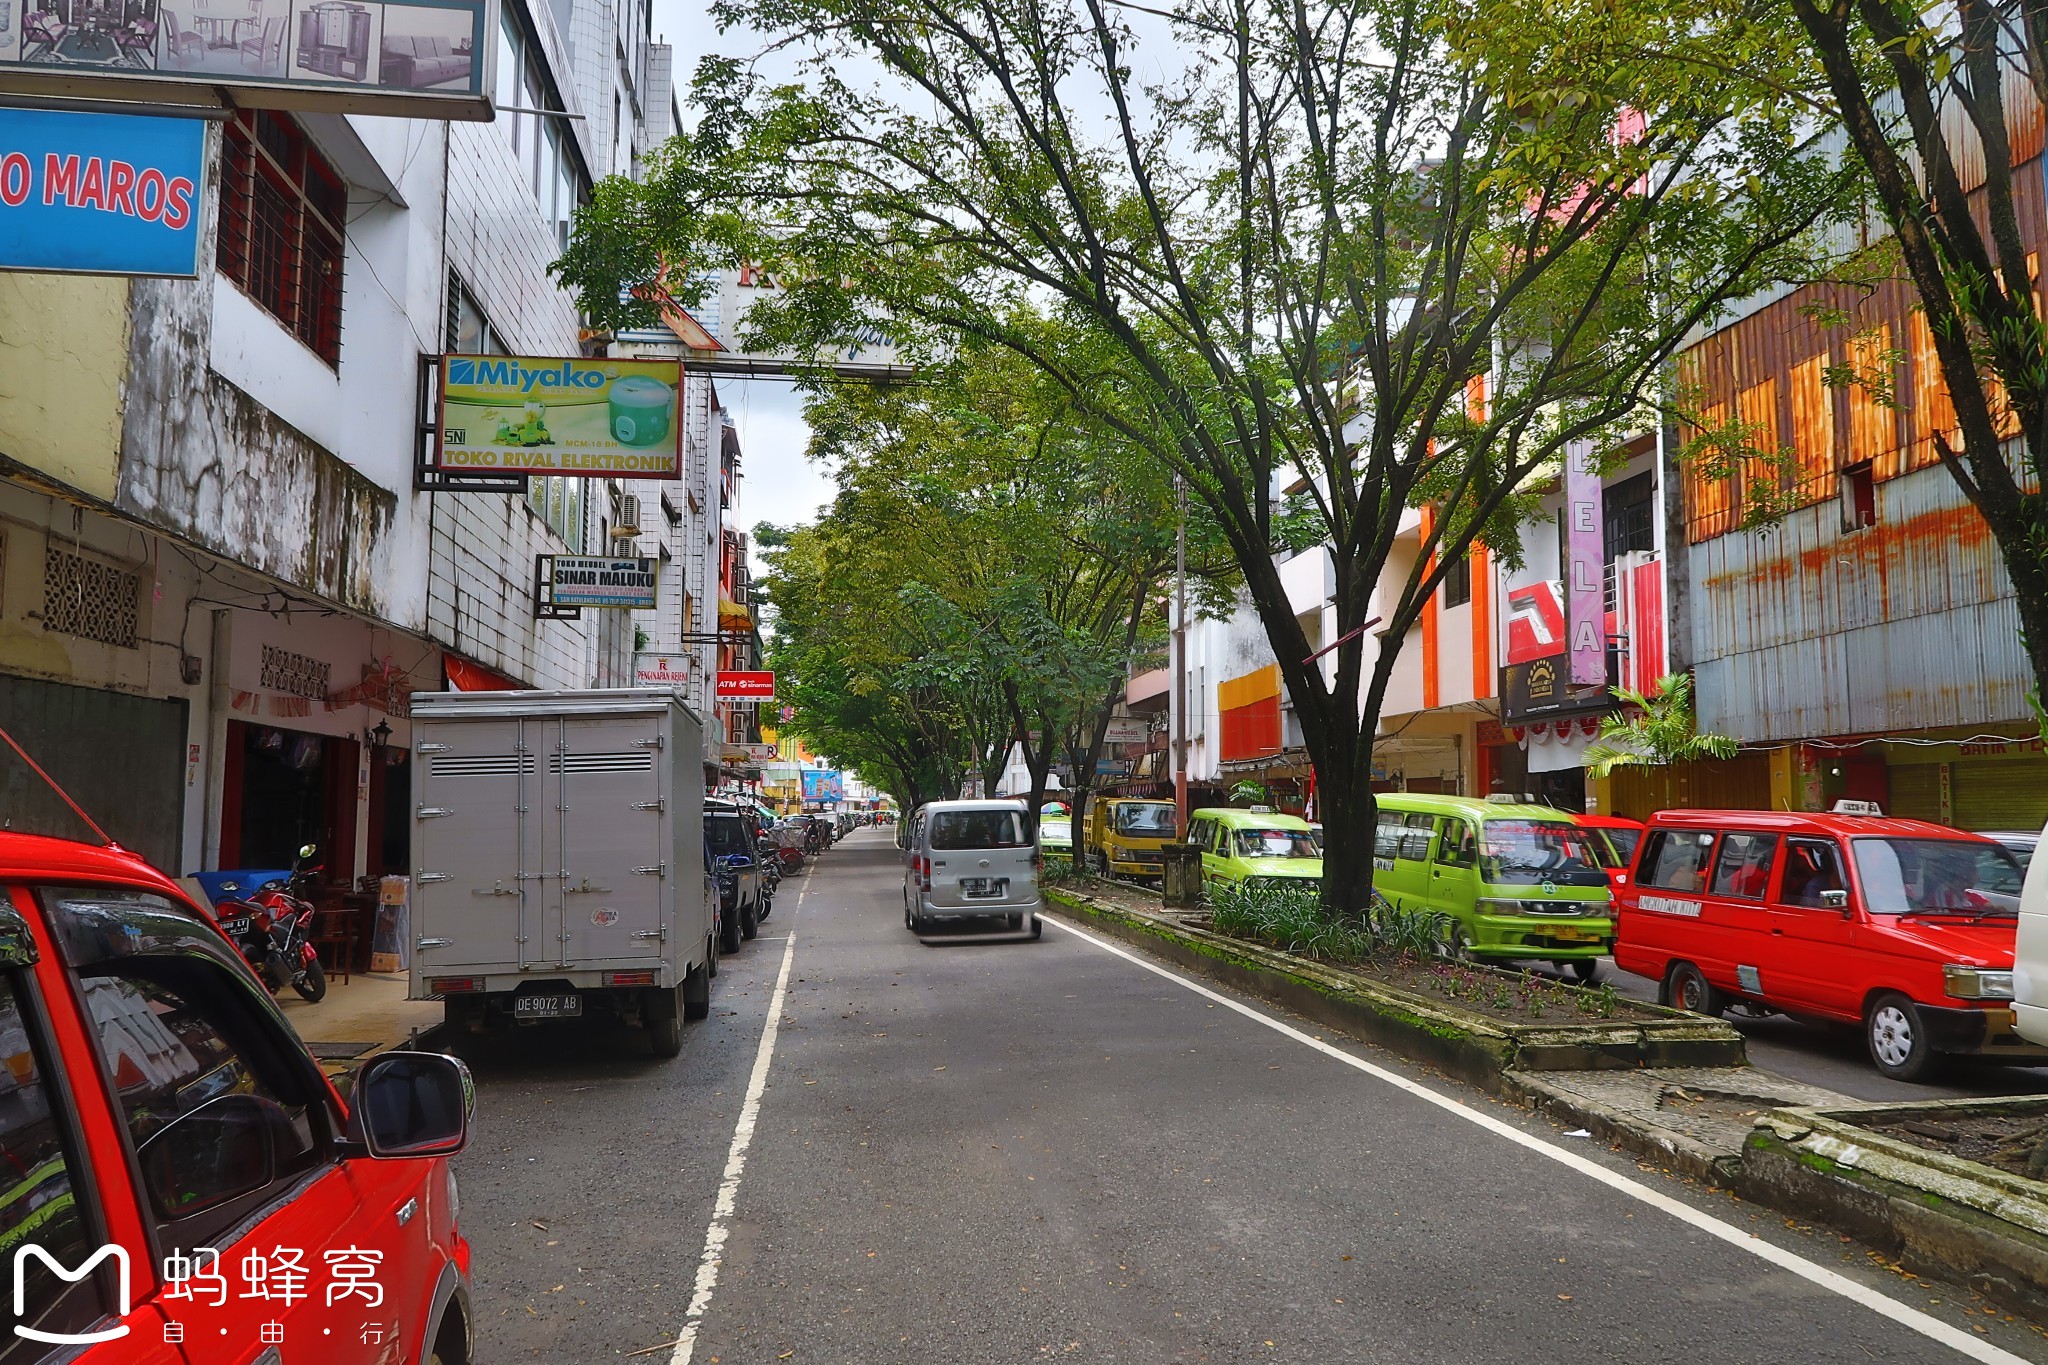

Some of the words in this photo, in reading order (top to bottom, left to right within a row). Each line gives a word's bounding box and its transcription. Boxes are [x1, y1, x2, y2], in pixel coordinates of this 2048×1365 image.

[0, 151, 32, 207] O
[42, 152, 194, 231] MAROS
[476, 360, 607, 394] Miyako
[444, 430, 466, 443] SNI
[444, 450, 498, 466] TOKO
[503, 452, 556, 468] RIVAL
[561, 453, 675, 471] ELEKTRONIK
[557, 560, 576, 568] TOKO
[578, 560, 606, 569] MEUBEL
[555, 569, 597, 586] SINAR
[600, 571, 655, 587] MALUKU
[659, 662, 668, 670] R
[1941, 765, 1949, 809] BATIK
[518, 998, 531, 1011] DE
[533, 997, 558, 1010] 9072
[563, 996, 577, 1010] AB
